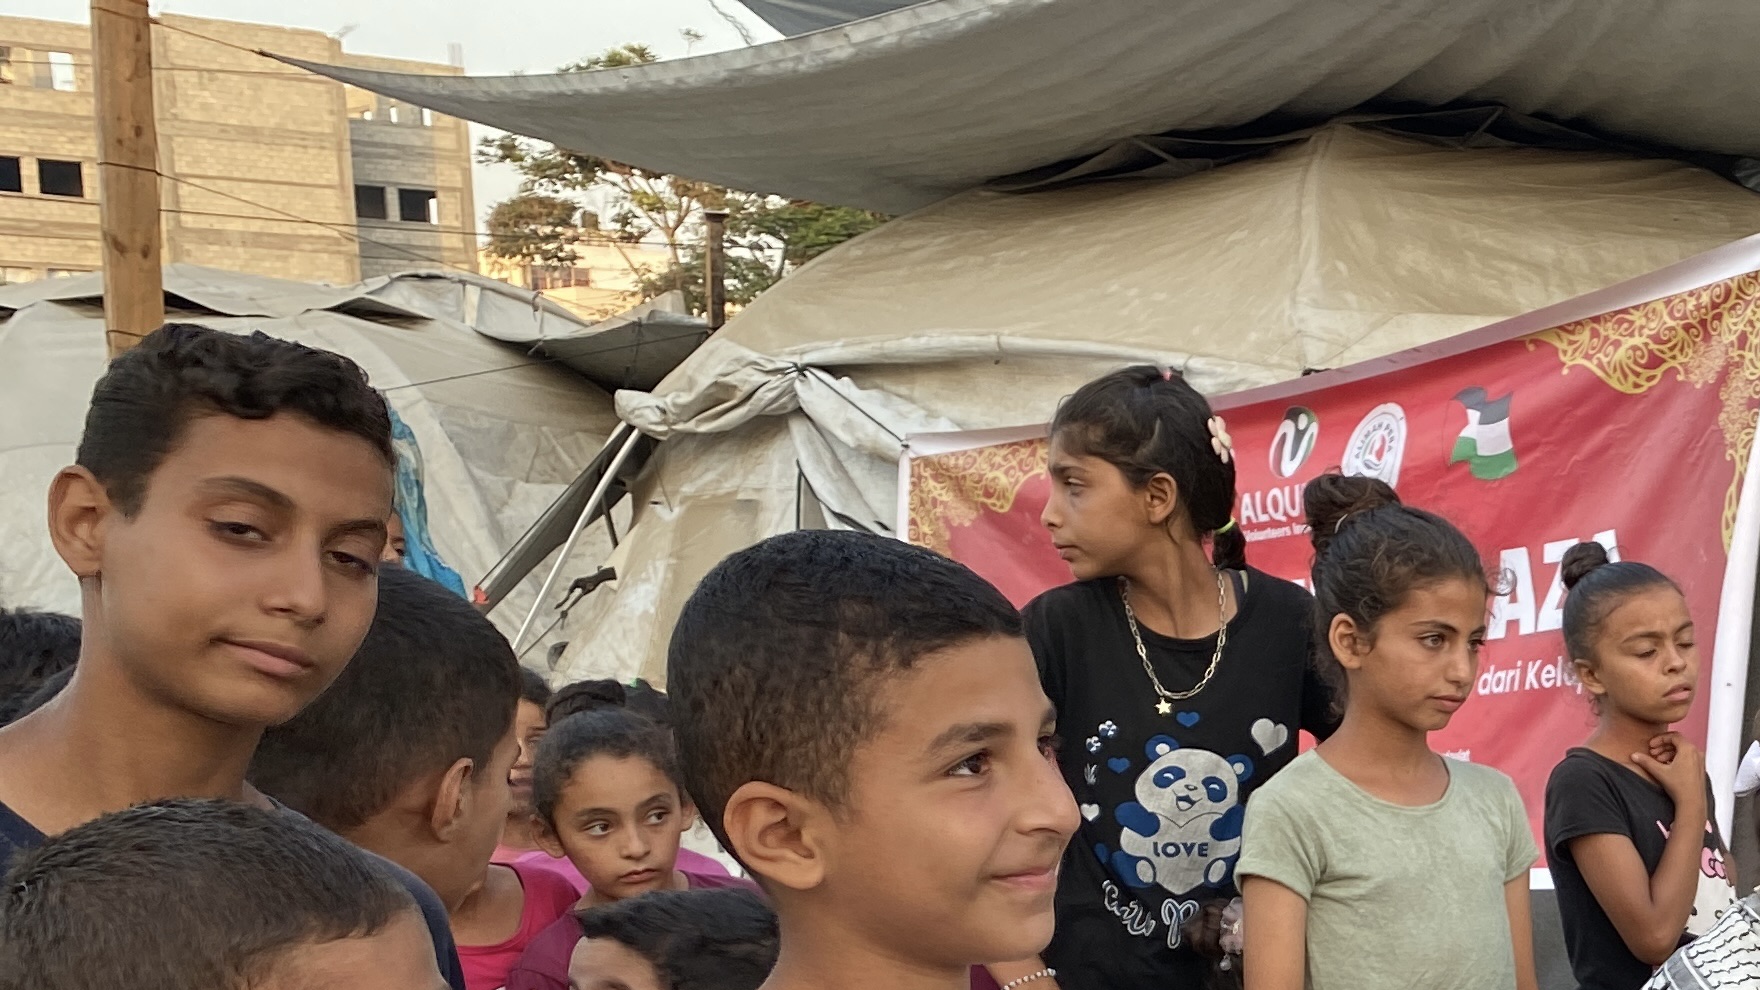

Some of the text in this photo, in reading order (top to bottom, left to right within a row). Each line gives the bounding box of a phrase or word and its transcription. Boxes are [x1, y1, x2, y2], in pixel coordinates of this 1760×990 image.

[1241, 482, 1306, 525] ALQU
[1477, 659, 1522, 696] dari
[1152, 841, 1209, 858] LOVE
